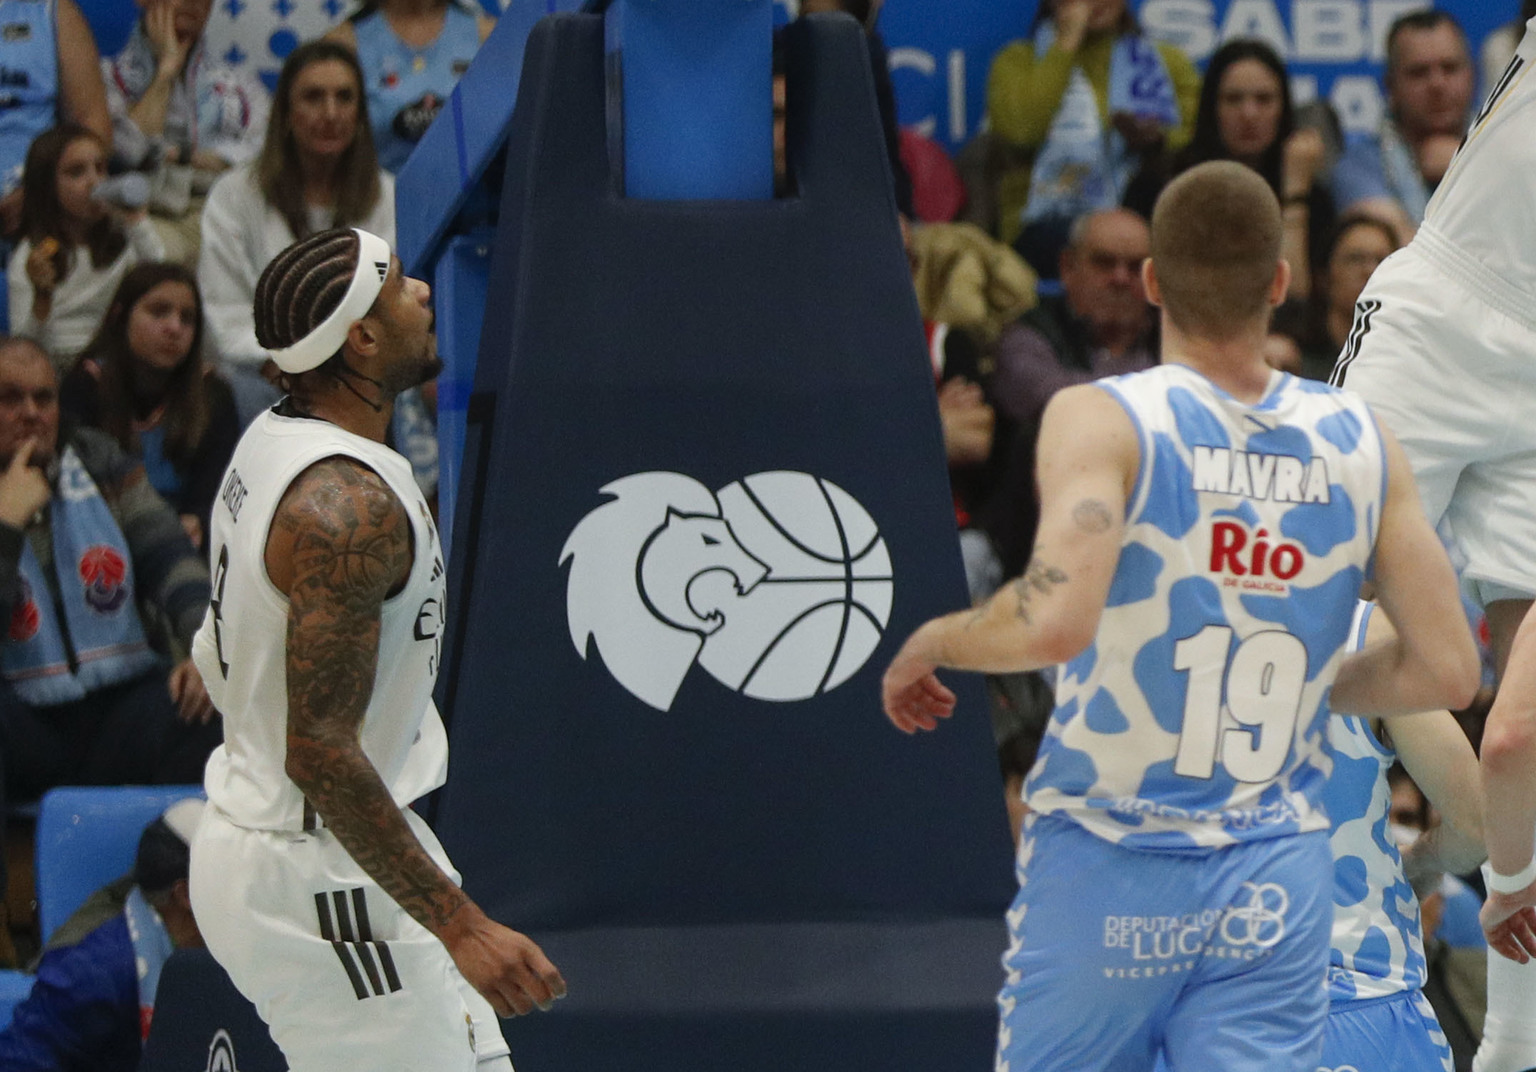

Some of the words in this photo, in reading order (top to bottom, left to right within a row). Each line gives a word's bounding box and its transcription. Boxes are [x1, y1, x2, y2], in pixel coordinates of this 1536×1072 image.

[1192, 445, 1331, 505] MAVRA
[1174, 625, 1308, 784] 19
[1105, 930, 1130, 948] DE
